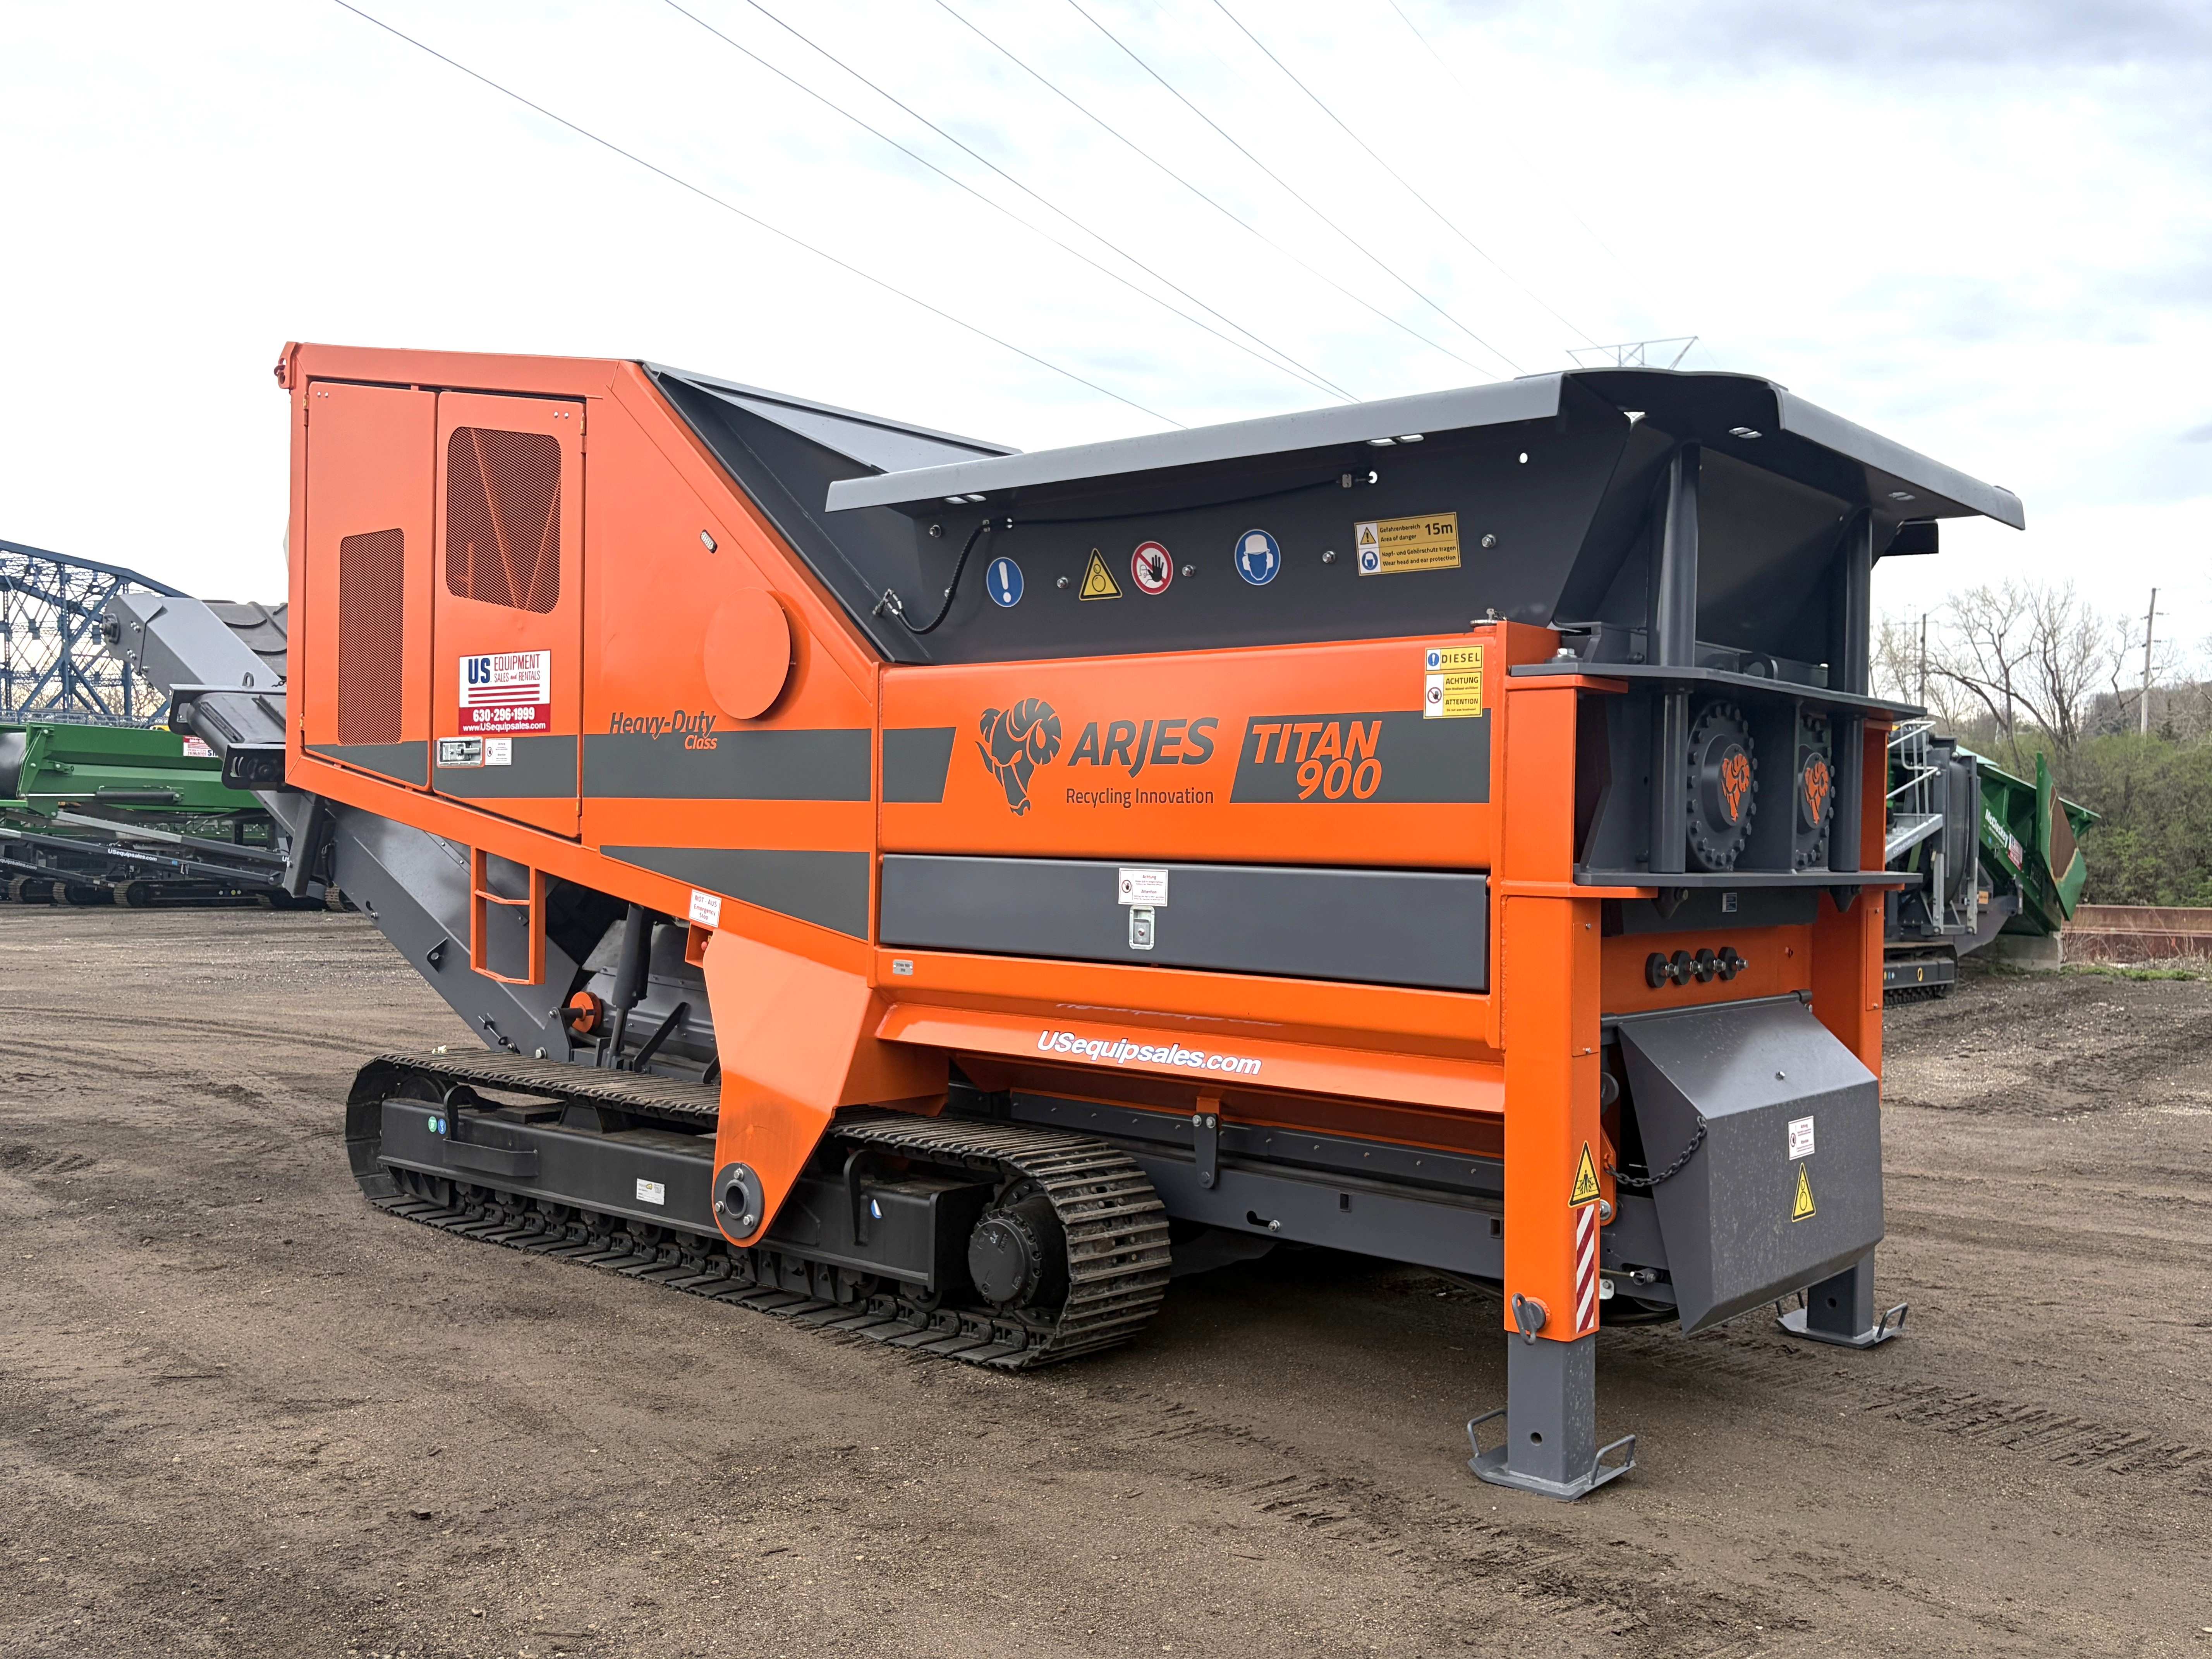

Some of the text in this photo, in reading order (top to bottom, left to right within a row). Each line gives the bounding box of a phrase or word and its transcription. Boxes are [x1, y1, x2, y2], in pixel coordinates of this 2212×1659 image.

[1380, 523, 1453, 535] Gefahrenbereich 15m
[494, 654, 541, 671] EQUIPMENT
[1441, 653, 1480, 663] DIESEL
[494, 673, 509, 683] SALES
[519, 670, 541, 681] RENTALS
[1446, 677, 1479, 685] ACHTUNG
[463, 721, 546, 732] www.USequipsales.com
[610, 709, 716, 740] Heavy-Duty
[684, 735, 718, 750] Class
[1067, 717, 1219, 778] ARJES
[1252, 720, 1382, 764] TITAN
[1297, 758, 1382, 800] 900
[1066, 787, 1214, 809] Recycling Innovation
[108, 848, 157, 862] USequipsales.com
[694, 904, 715, 916] Emergency
[708, 899, 717, 907] AUS
[699, 912, 709, 921] Stop
[1037, 1030, 1263, 1076] USequipsales.com
